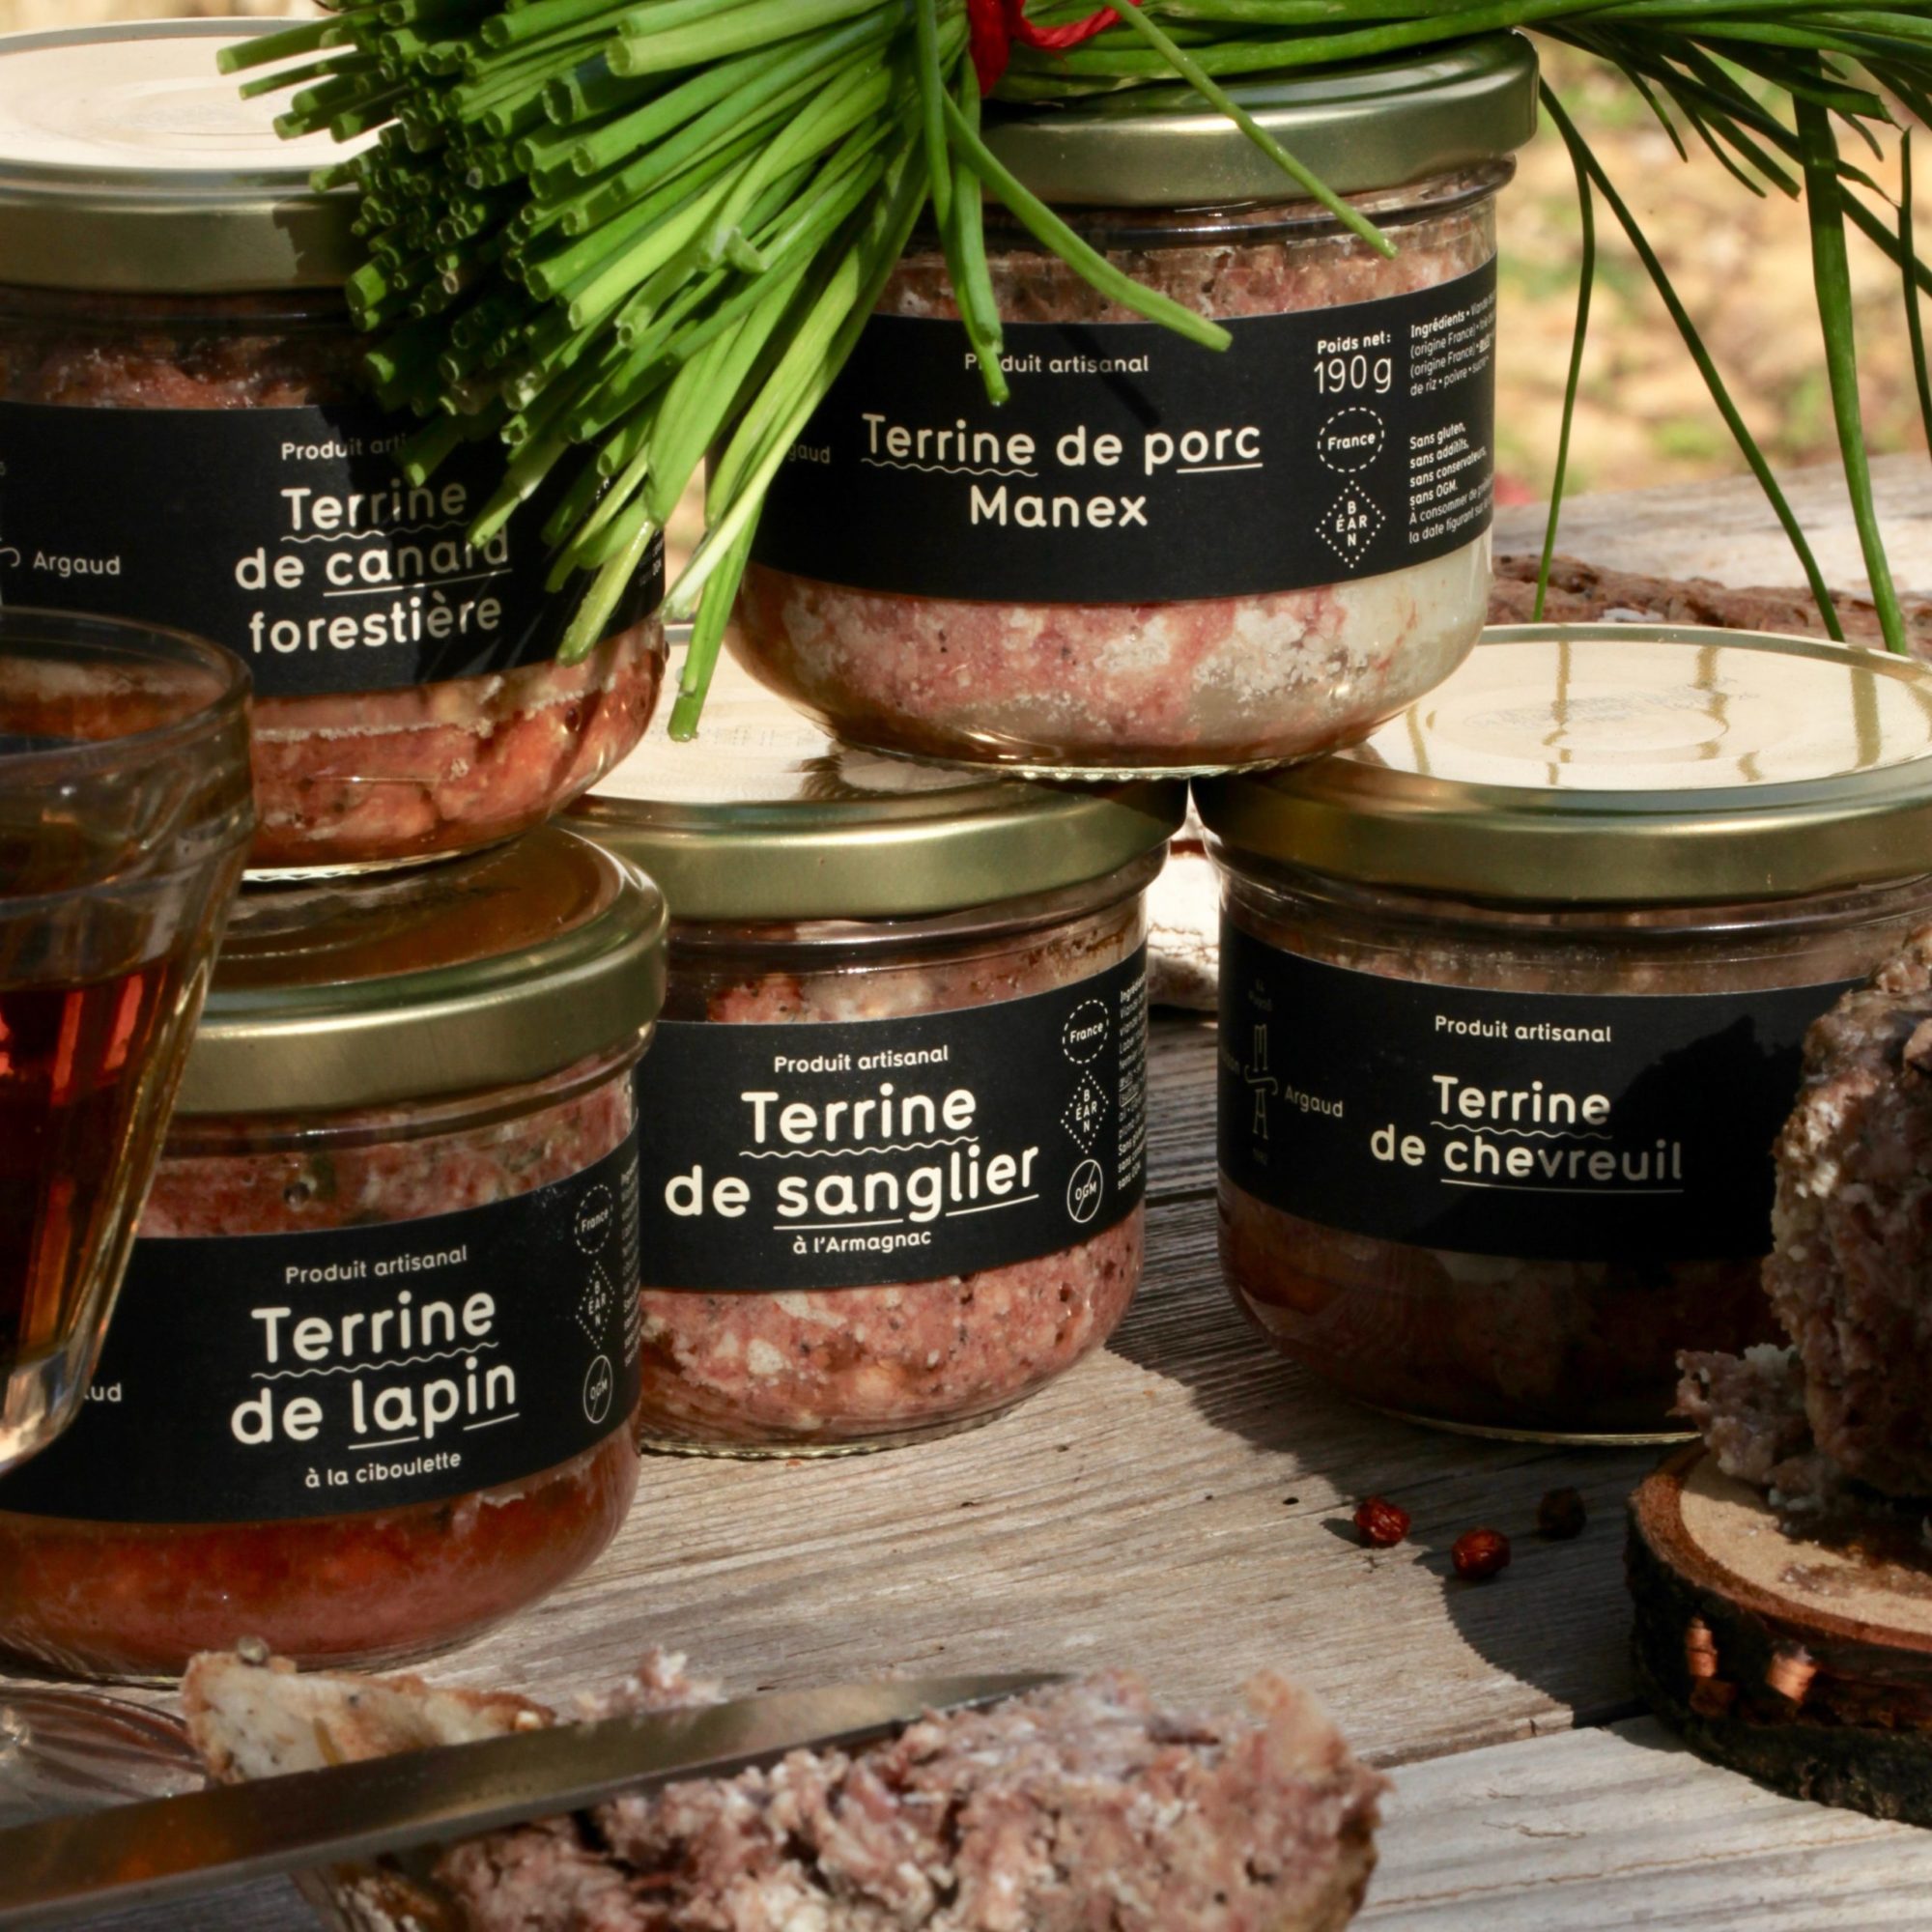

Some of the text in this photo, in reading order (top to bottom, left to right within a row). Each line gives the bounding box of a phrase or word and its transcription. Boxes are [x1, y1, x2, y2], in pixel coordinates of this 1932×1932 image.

[1318, 331, 1391, 355] Poids net:
[964, 352, 1150, 374] Pduit artisanal
[280, 438, 363, 461] Produit
[785, 441, 833, 466] gaud
[862, 412, 1261, 476] Terrine de porc
[1328, 434, 1377, 451] France
[1409, 436, 1435, 450] Sans
[1409, 455, 1435, 469] sans
[1409, 473, 1435, 488] sans
[280, 478, 468, 530] Terrine
[971, 485, 1149, 528] Manex
[1409, 492, 1435, 507] sans
[1409, 532, 1420, 544] la
[1422, 524, 1443, 541] date
[34, 552, 121, 579] Argaud
[236, 523, 509, 590] de canard
[247, 591, 502, 655] forestière
[1069, 1022, 1104, 1044] France
[1435, 1015, 1611, 1043] Produit artisanal
[775, 1045, 949, 1073] Produit artisanal
[739, 1080, 978, 1145] Terrine
[1285, 1085, 1344, 1119] Argaud
[1430, 1072, 1612, 1126] Terrine
[1371, 1124, 1683, 1180] de chevreuil
[666, 1144, 1040, 1223] de sanglier
[793, 1236, 808, 1255] à
[286, 1245, 468, 1285] Produit artisanal
[249, 1289, 497, 1365] Terrine
[232, 1355, 516, 1445] de lapin
[305, 1452, 463, 1489] à la ciboulette
